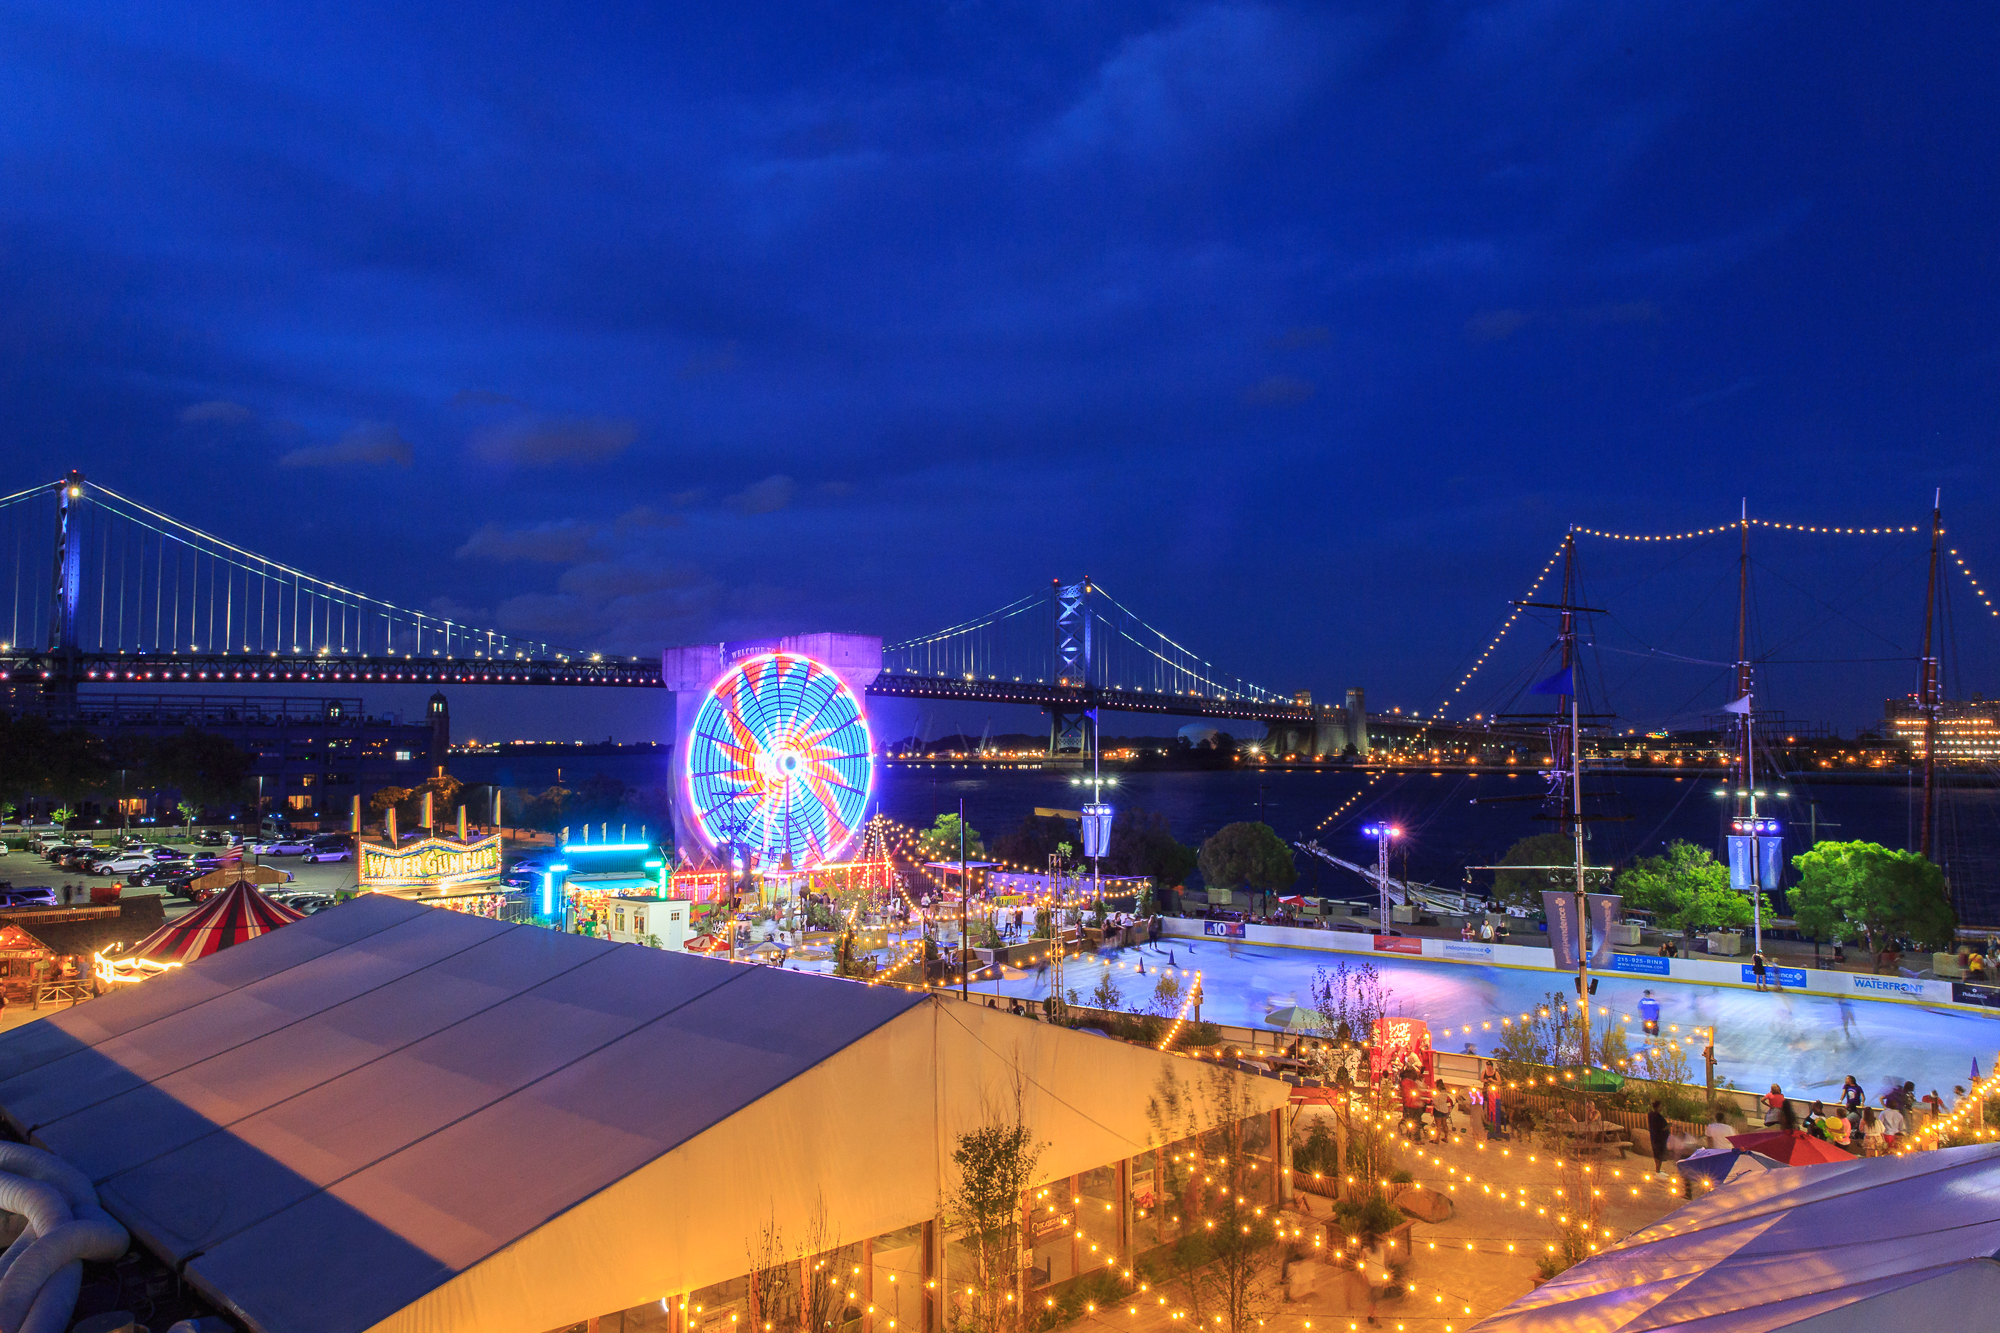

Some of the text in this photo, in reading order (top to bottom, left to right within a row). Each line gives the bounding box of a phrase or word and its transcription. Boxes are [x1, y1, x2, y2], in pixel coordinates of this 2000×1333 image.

[731, 647, 765, 659] WELCOME
[367, 848, 494, 877] WATER GUN FUN
[1213, 922, 1227, 936] 10
[1445, 945, 1484, 953] Independence
[1617, 956, 1664, 965] 215-925-RINK
[1854, 979, 1924, 993] WATERFRONT
